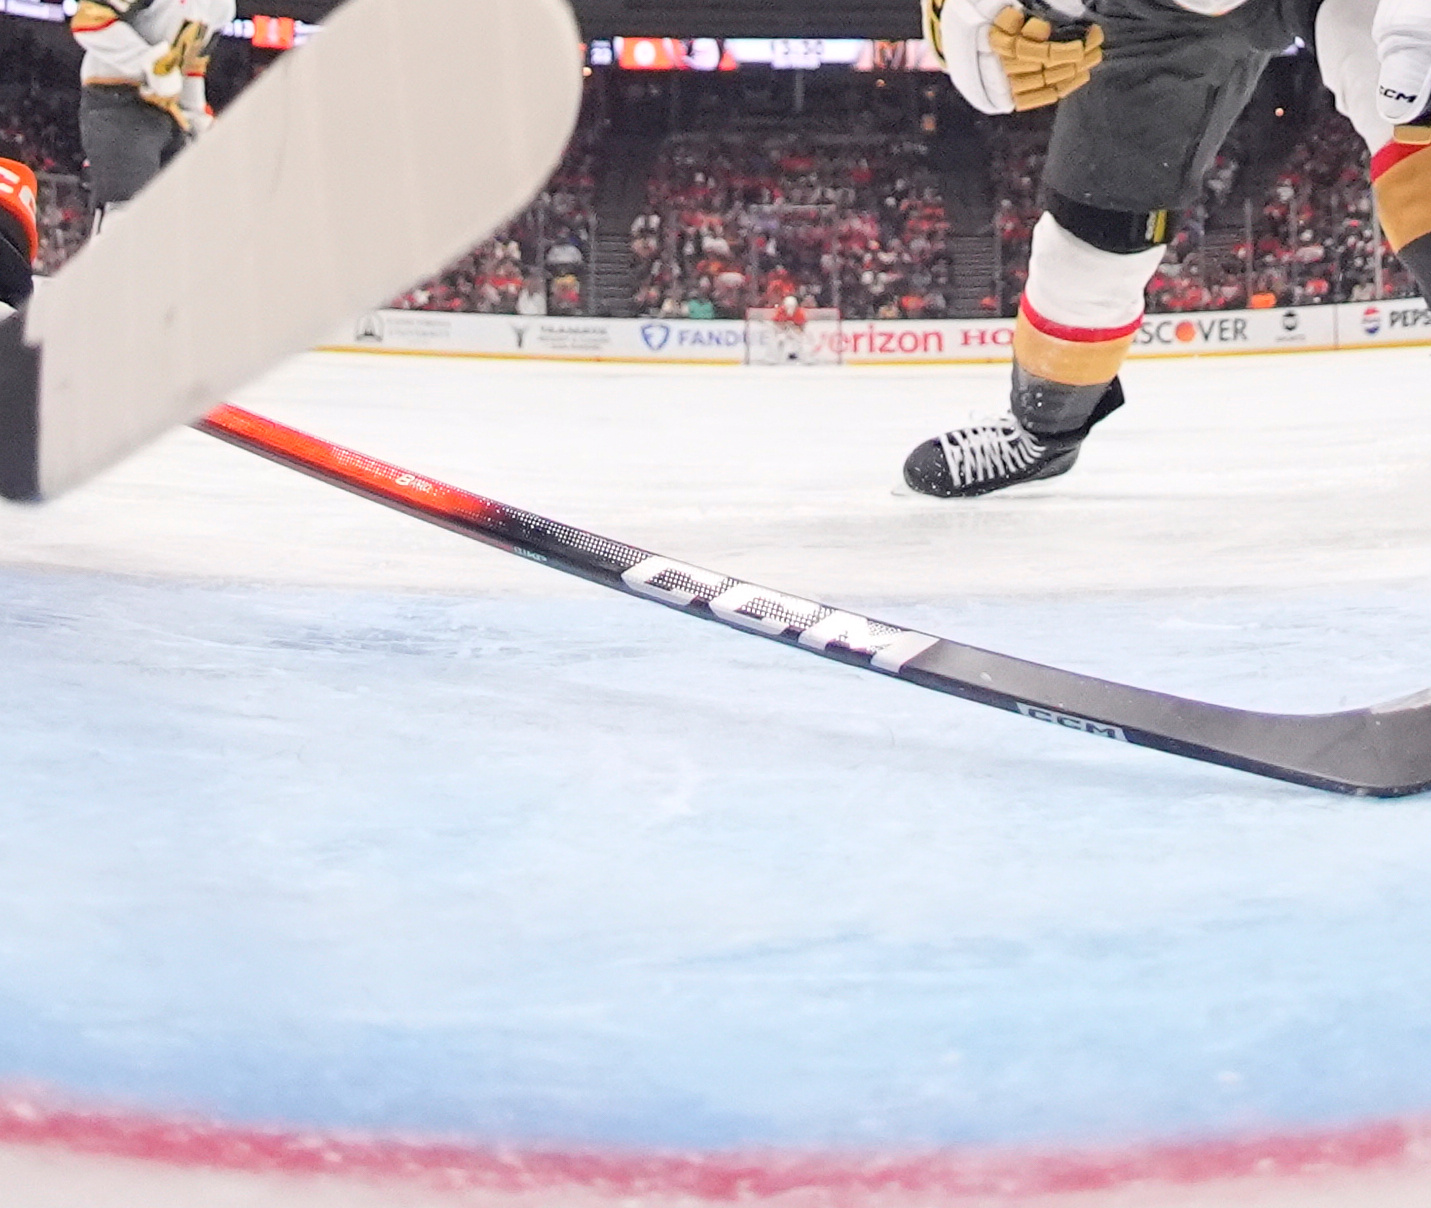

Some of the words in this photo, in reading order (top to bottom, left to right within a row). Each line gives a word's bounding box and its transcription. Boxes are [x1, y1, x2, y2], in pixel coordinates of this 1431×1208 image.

[1135, 317, 1248, 345] SCOVER
[621, 554, 942, 674] CCM
[1028, 707, 1117, 739] CCM
